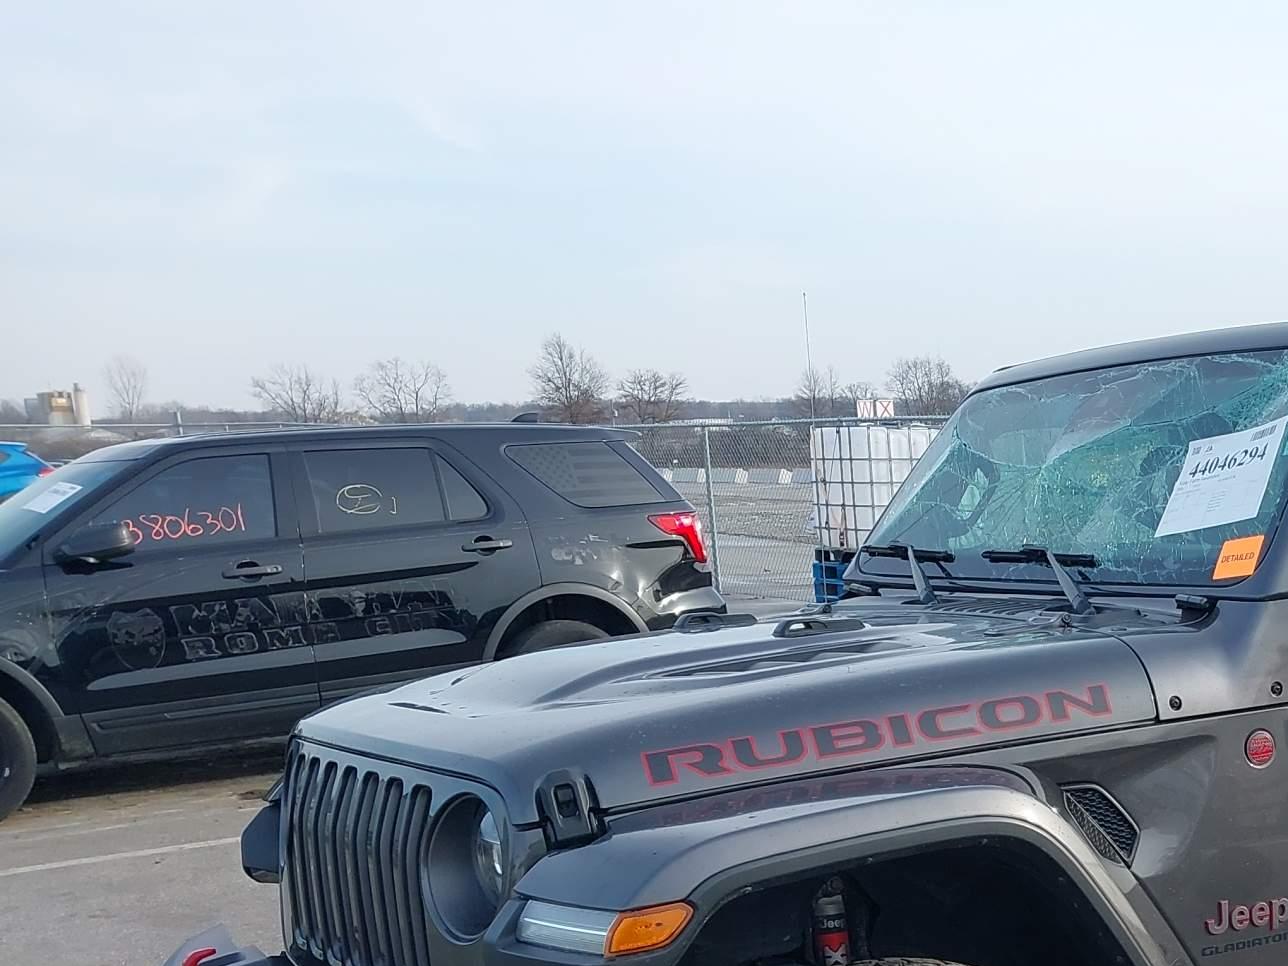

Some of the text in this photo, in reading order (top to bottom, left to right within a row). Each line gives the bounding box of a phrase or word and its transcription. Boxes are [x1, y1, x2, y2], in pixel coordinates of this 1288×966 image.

[1189, 442, 1269, 478] 44046294
[1220, 551, 1256, 564] DETAILED
[641, 681, 1114, 787] RUBICON
